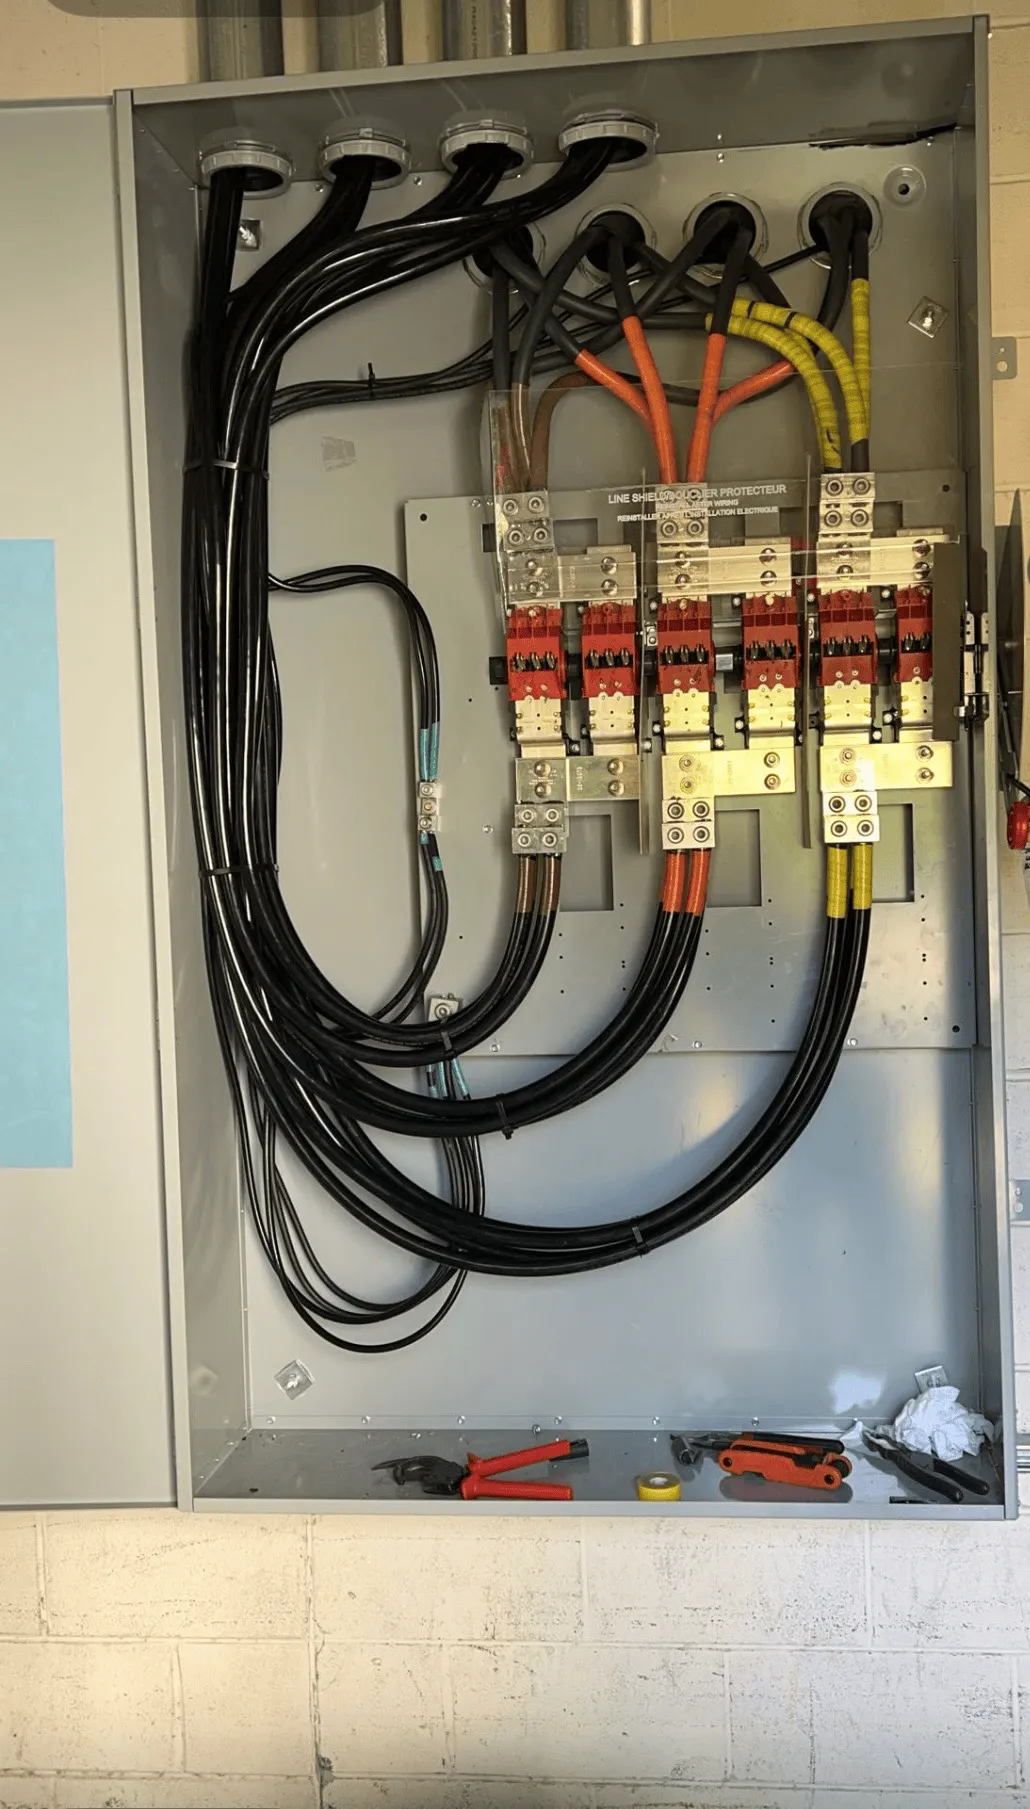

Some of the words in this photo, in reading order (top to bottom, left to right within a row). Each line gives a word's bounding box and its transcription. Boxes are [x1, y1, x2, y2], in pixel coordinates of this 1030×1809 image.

[608, 493, 631, 504] LINE
[720, 484, 787, 497] PROTECTEUR
[714, 499, 739, 507] WIRING
